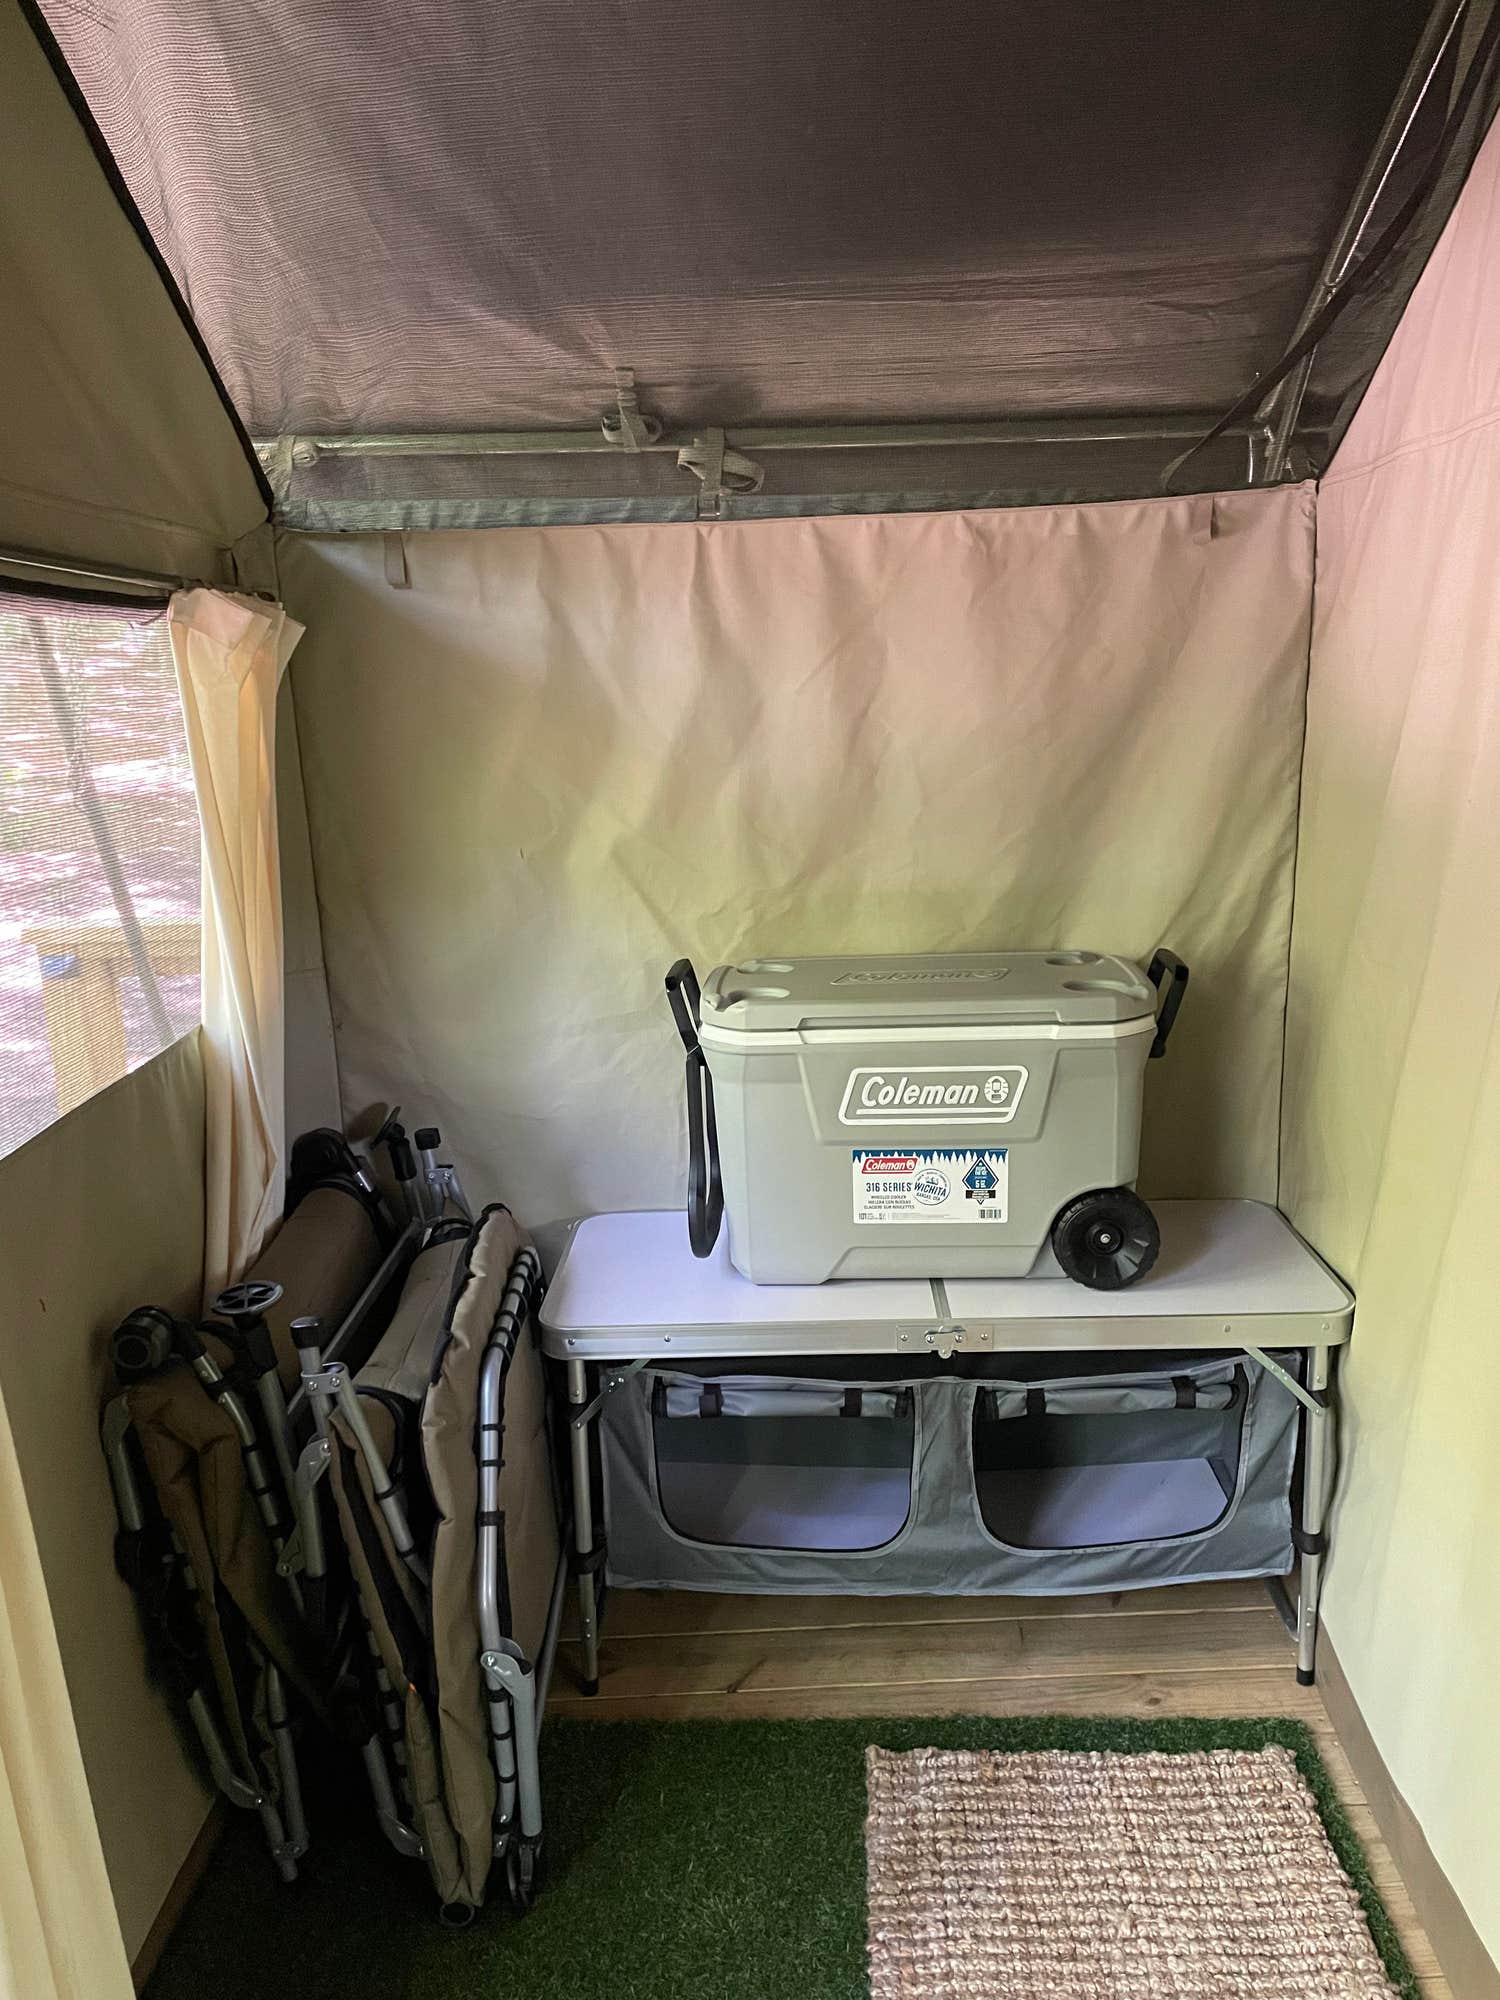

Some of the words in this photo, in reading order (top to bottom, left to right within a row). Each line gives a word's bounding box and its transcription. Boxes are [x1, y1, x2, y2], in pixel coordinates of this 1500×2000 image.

[860, 1075, 979, 1107] Coleman
[865, 1160, 905, 1170] Coleman
[865, 1182, 881, 1193] 316
[882, 1182, 911, 1192] SERIES
[914, 1181, 947, 1197] WICHITA
